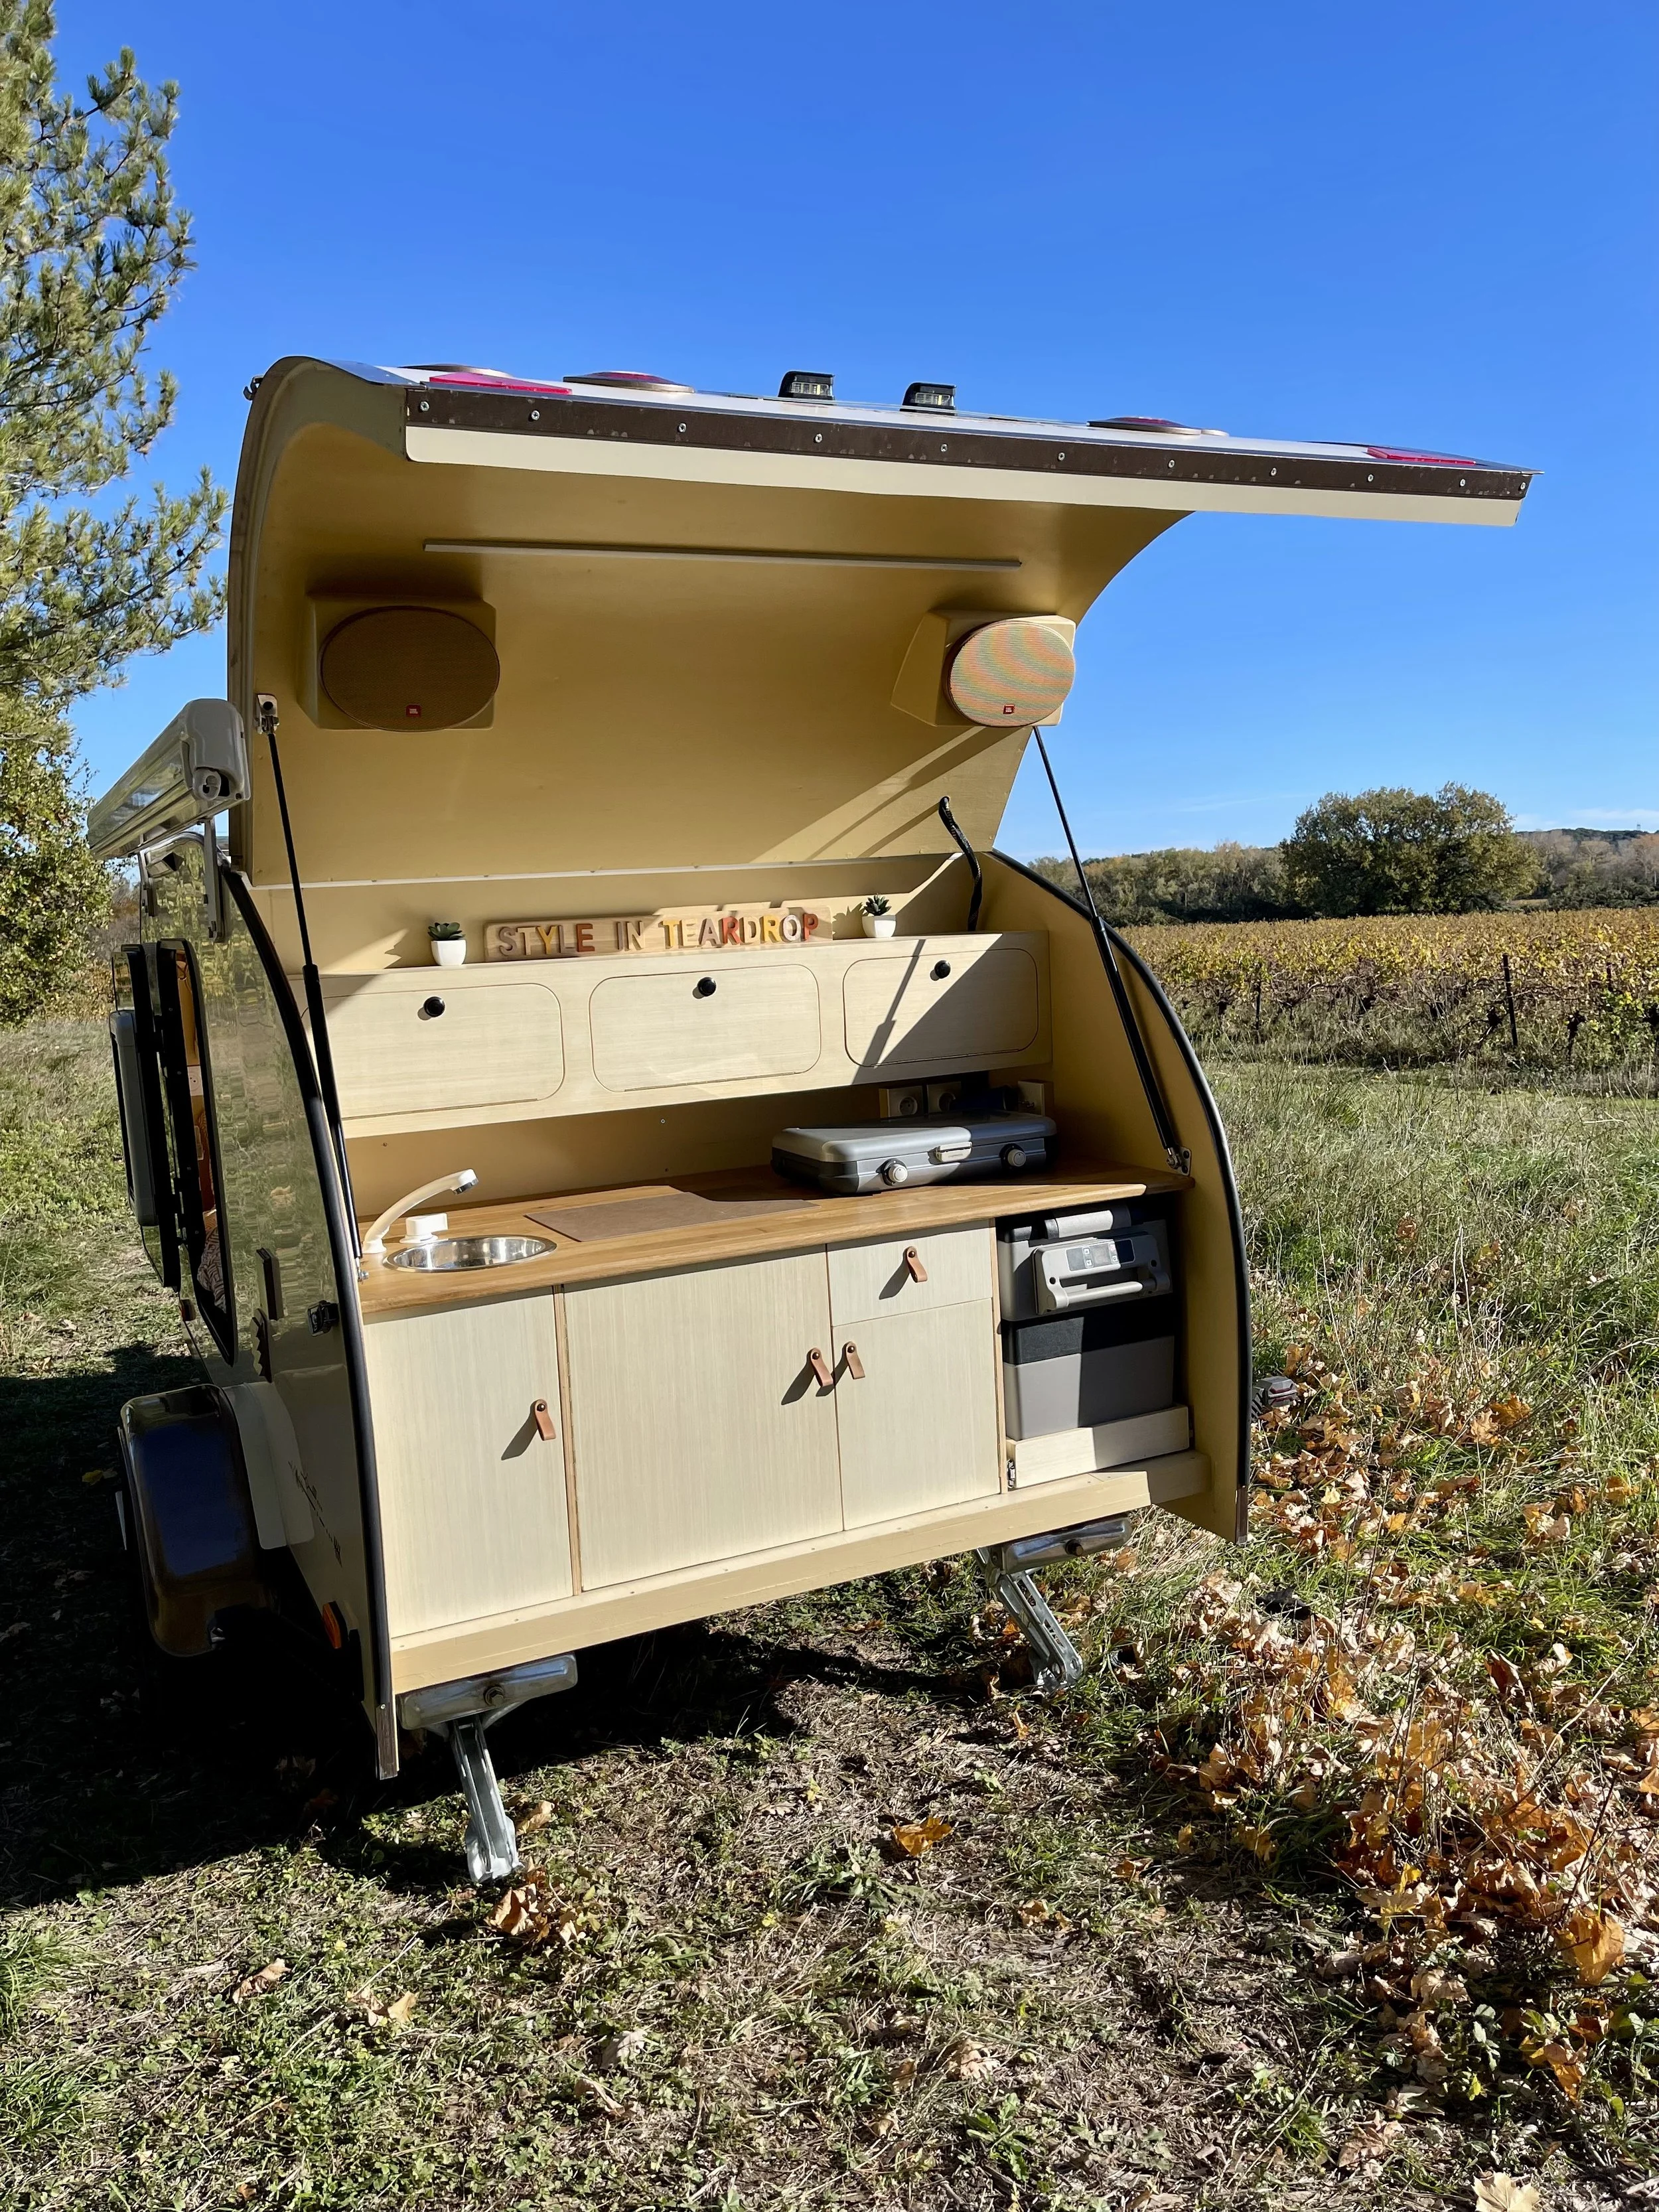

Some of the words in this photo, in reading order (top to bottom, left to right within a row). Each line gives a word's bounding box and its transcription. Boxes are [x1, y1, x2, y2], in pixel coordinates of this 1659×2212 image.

[498, 923, 595, 956] STYLE
[616, 921, 645, 950] IN
[660, 913, 819, 949] TEARDROP
